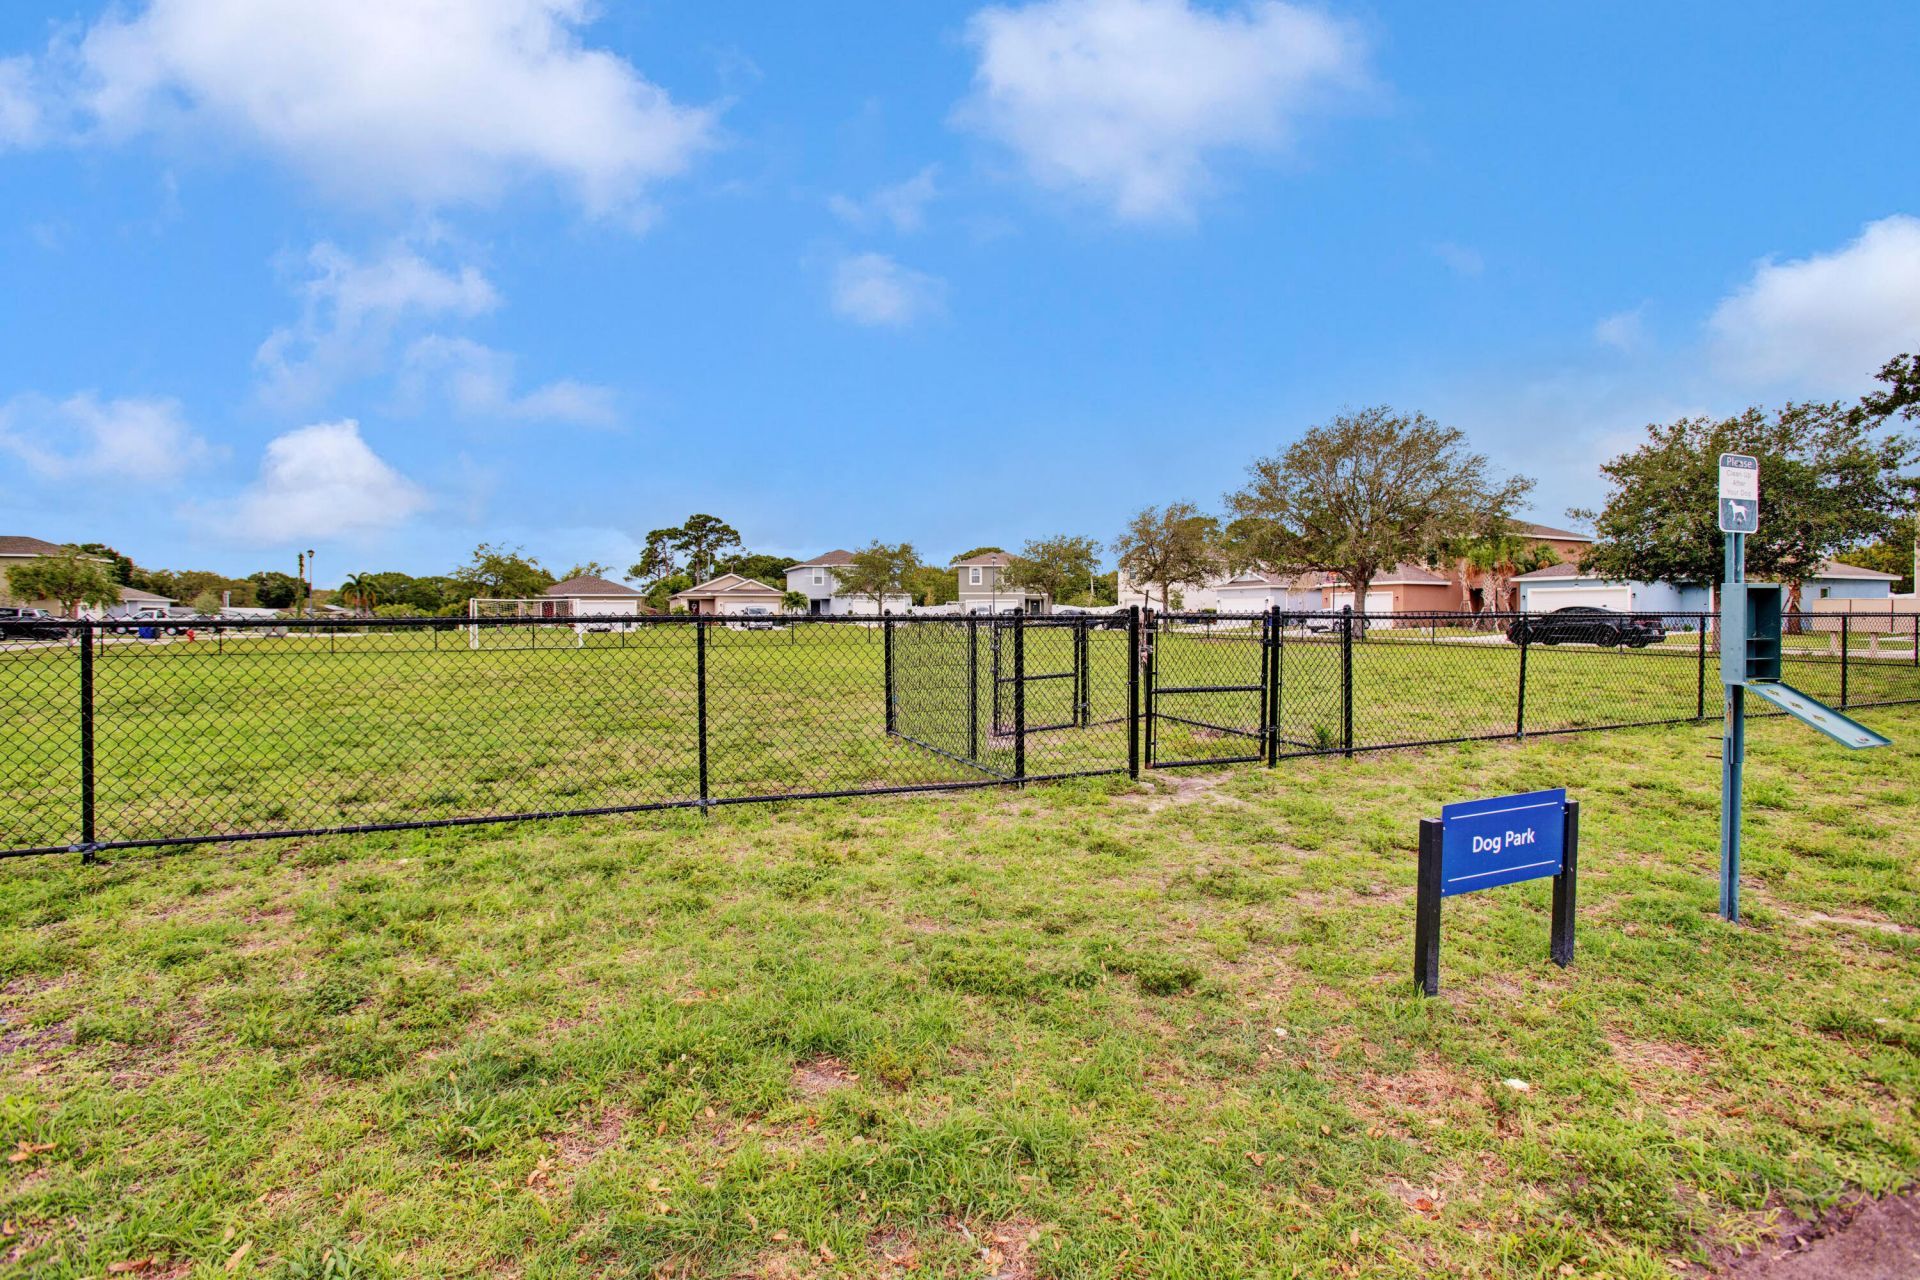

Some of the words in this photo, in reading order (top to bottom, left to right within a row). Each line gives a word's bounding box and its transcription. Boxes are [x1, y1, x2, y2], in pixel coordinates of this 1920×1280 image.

[1726, 457, 1752, 468] Please
[1472, 836, 1501, 854] Dog
[1505, 828, 1535, 847] Park
